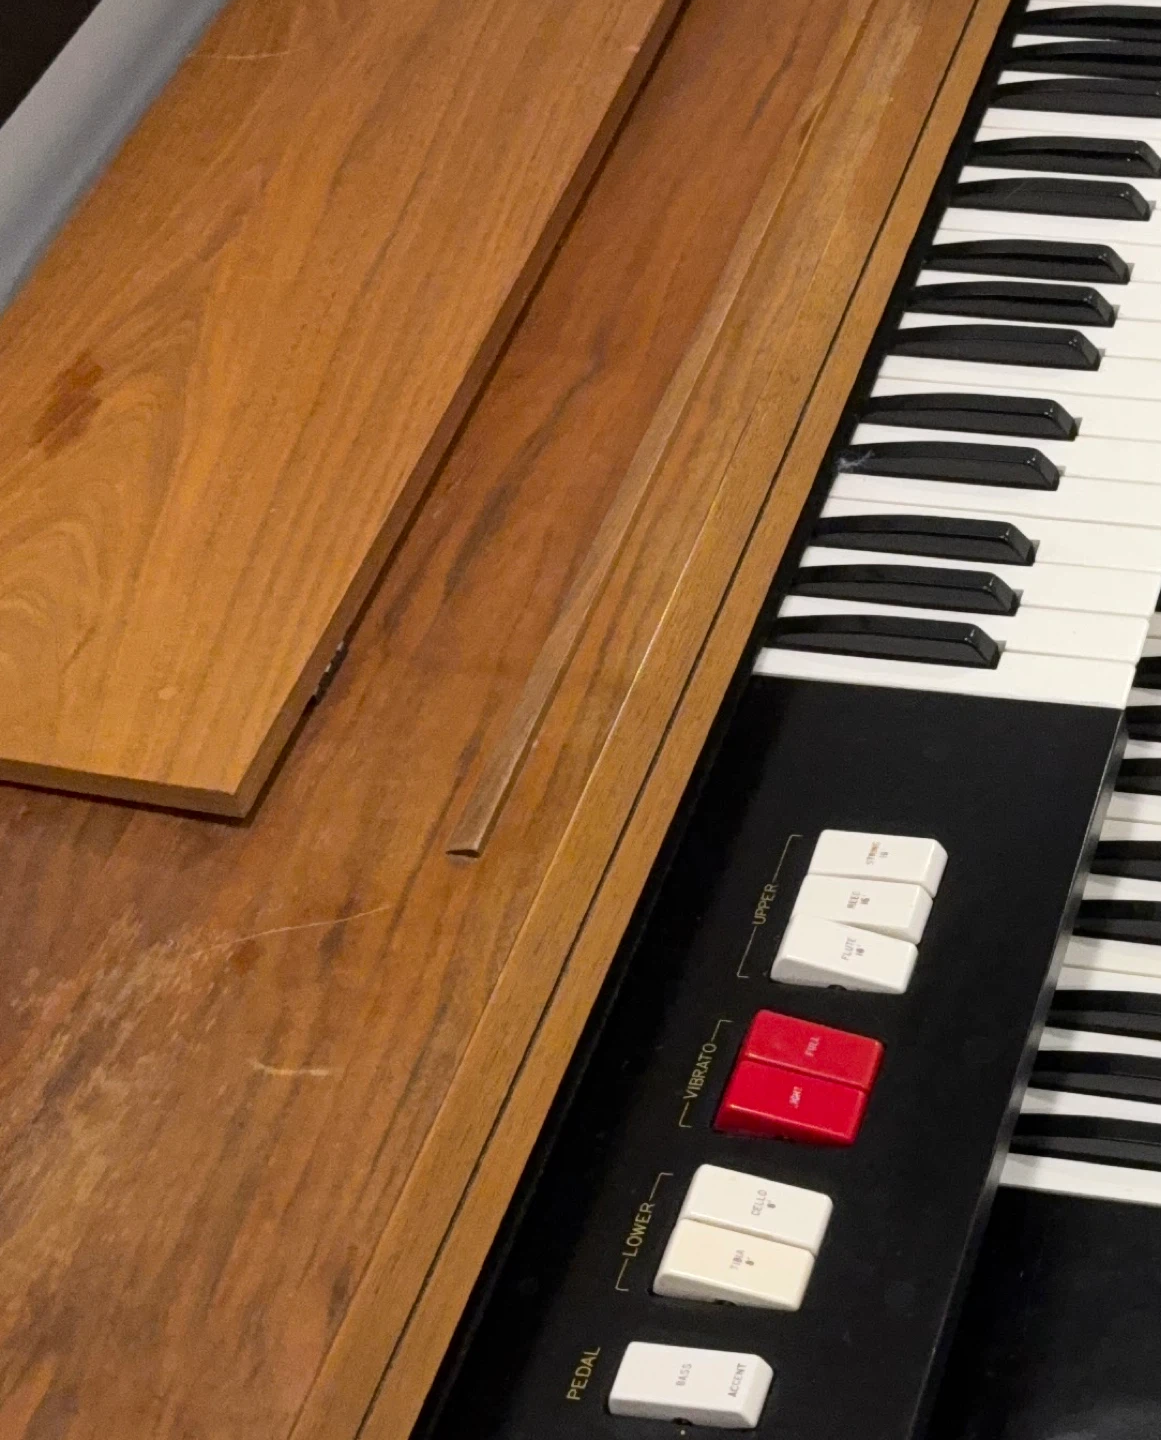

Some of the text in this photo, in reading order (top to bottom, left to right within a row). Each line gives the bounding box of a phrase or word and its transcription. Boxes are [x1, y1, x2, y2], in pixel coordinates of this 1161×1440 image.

[752, 883, 778, 926] UPPER
[841, 937, 857, 961] FLUTE
[683, 1042, 718, 1102] VIBRATO
[751, 1189, 767, 1216] CELLO
[622, 1202, 655, 1258] LOWER
[566, 1346, 601, 1401] PEDAL
[676, 1363, 692, 1387] BASS
[728, 1363, 747, 1398] ACCENT
